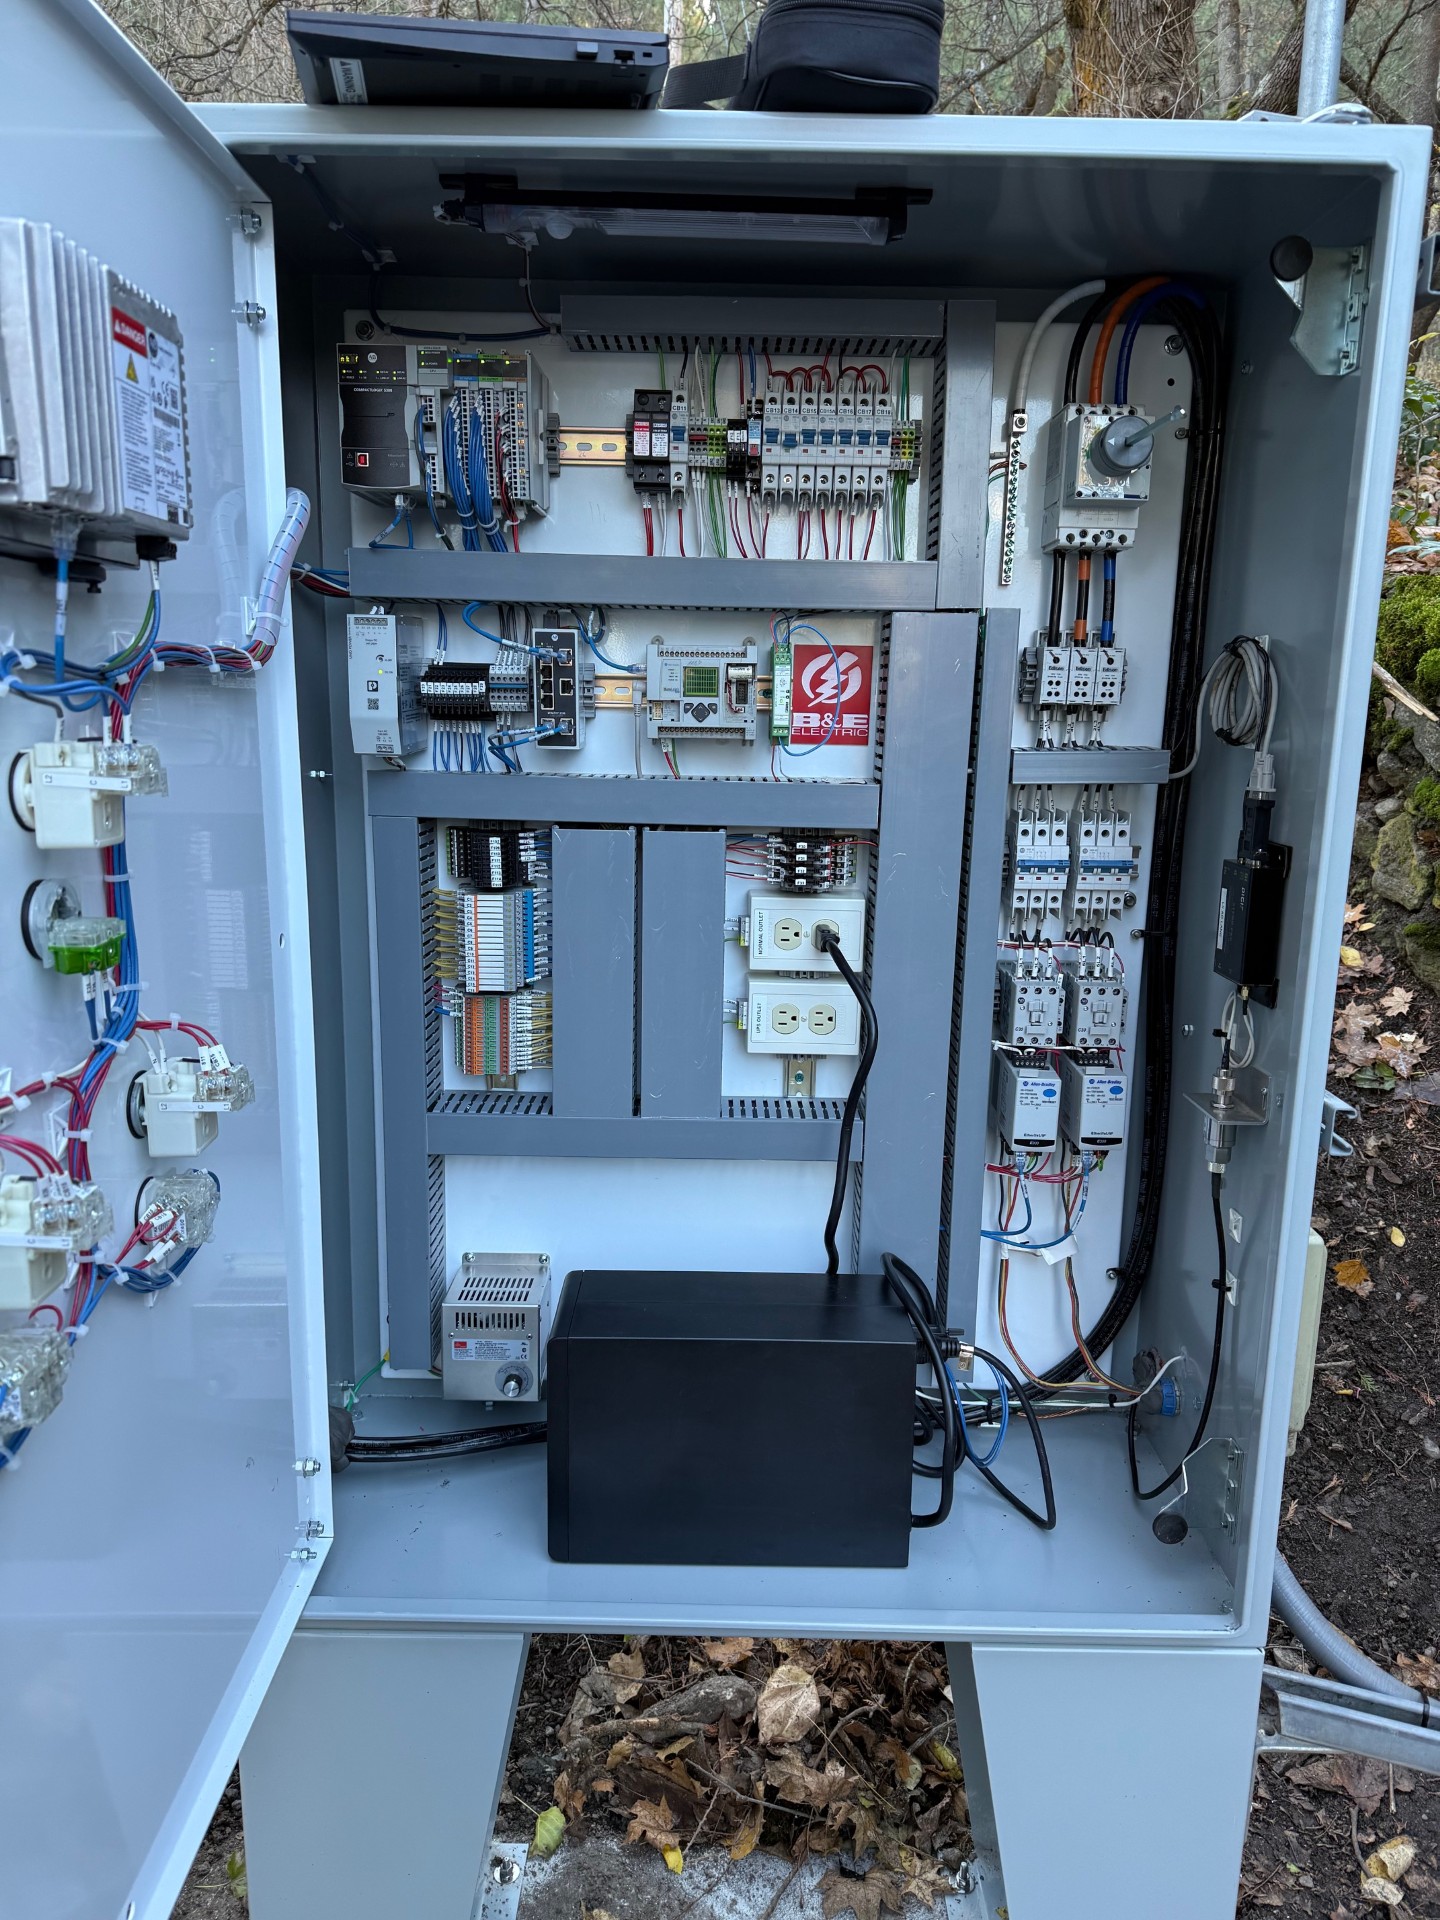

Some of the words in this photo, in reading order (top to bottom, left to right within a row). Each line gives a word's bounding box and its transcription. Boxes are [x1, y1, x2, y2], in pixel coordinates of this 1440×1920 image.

[341, 68, 356, 92] WARNING
[121, 324, 146, 346] DANGER
[792, 713, 868, 728] B&E
[792, 728, 868, 736] ELECTRIC
[45, 775, 52, 783] L2
[121, 780, 128, 788] L1
